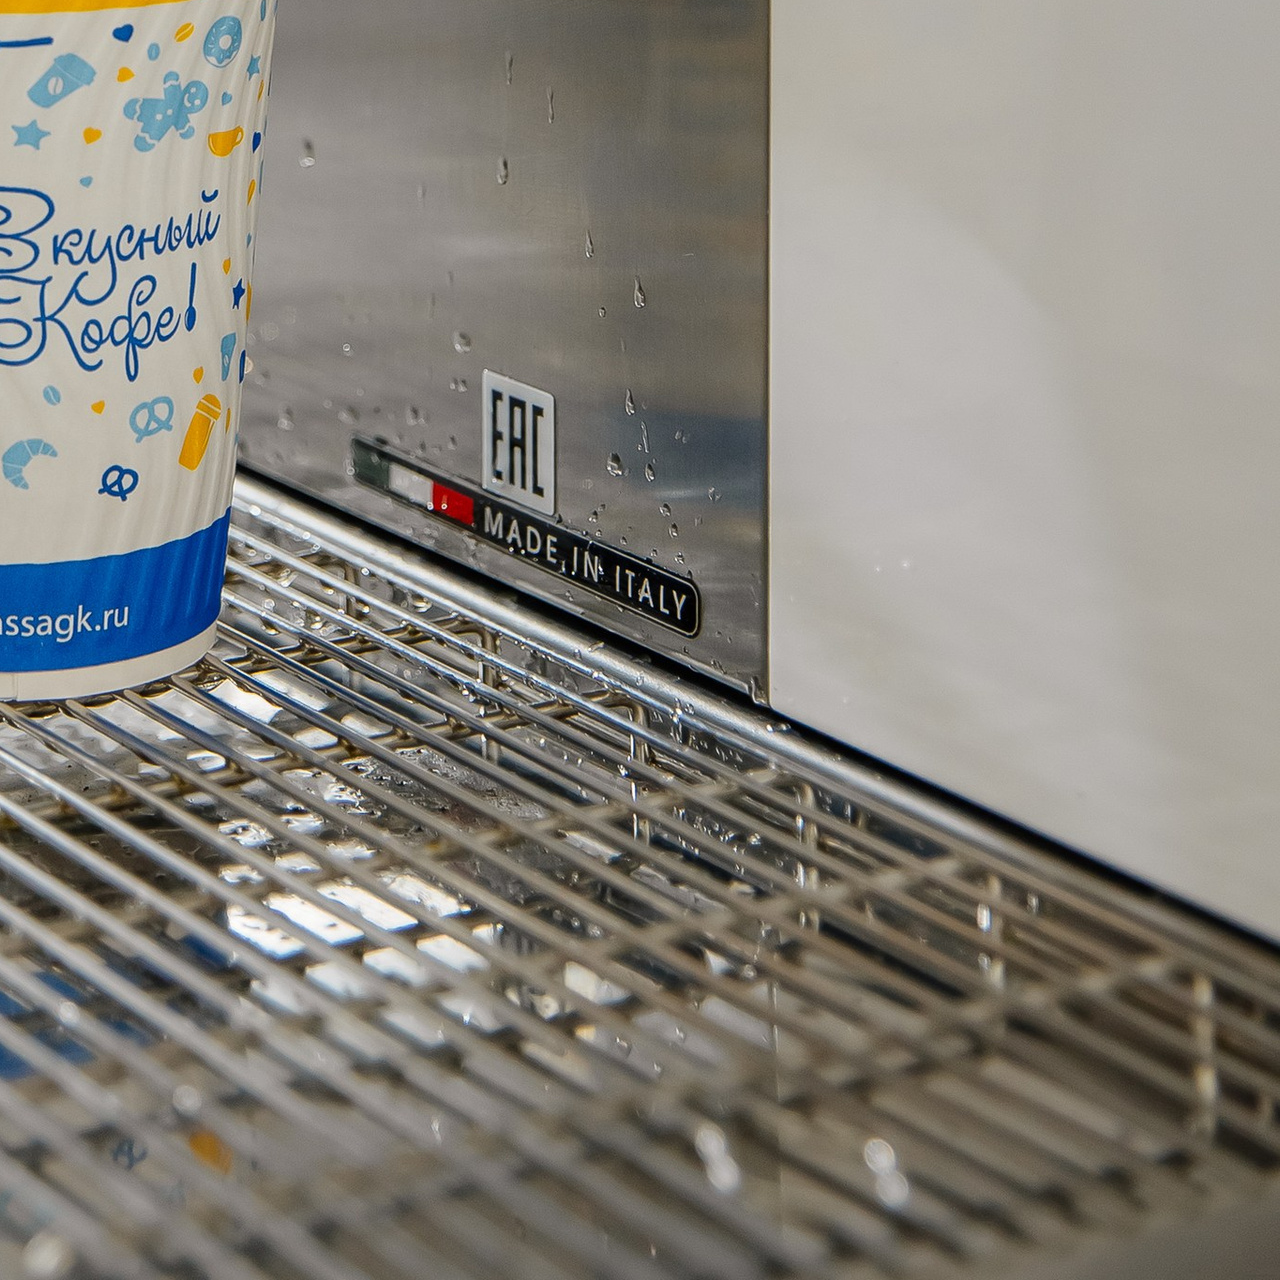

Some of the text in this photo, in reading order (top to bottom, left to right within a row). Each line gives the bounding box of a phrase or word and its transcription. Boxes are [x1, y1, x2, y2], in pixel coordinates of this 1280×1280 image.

[484, 506, 687, 621] MADE IN ITALY
